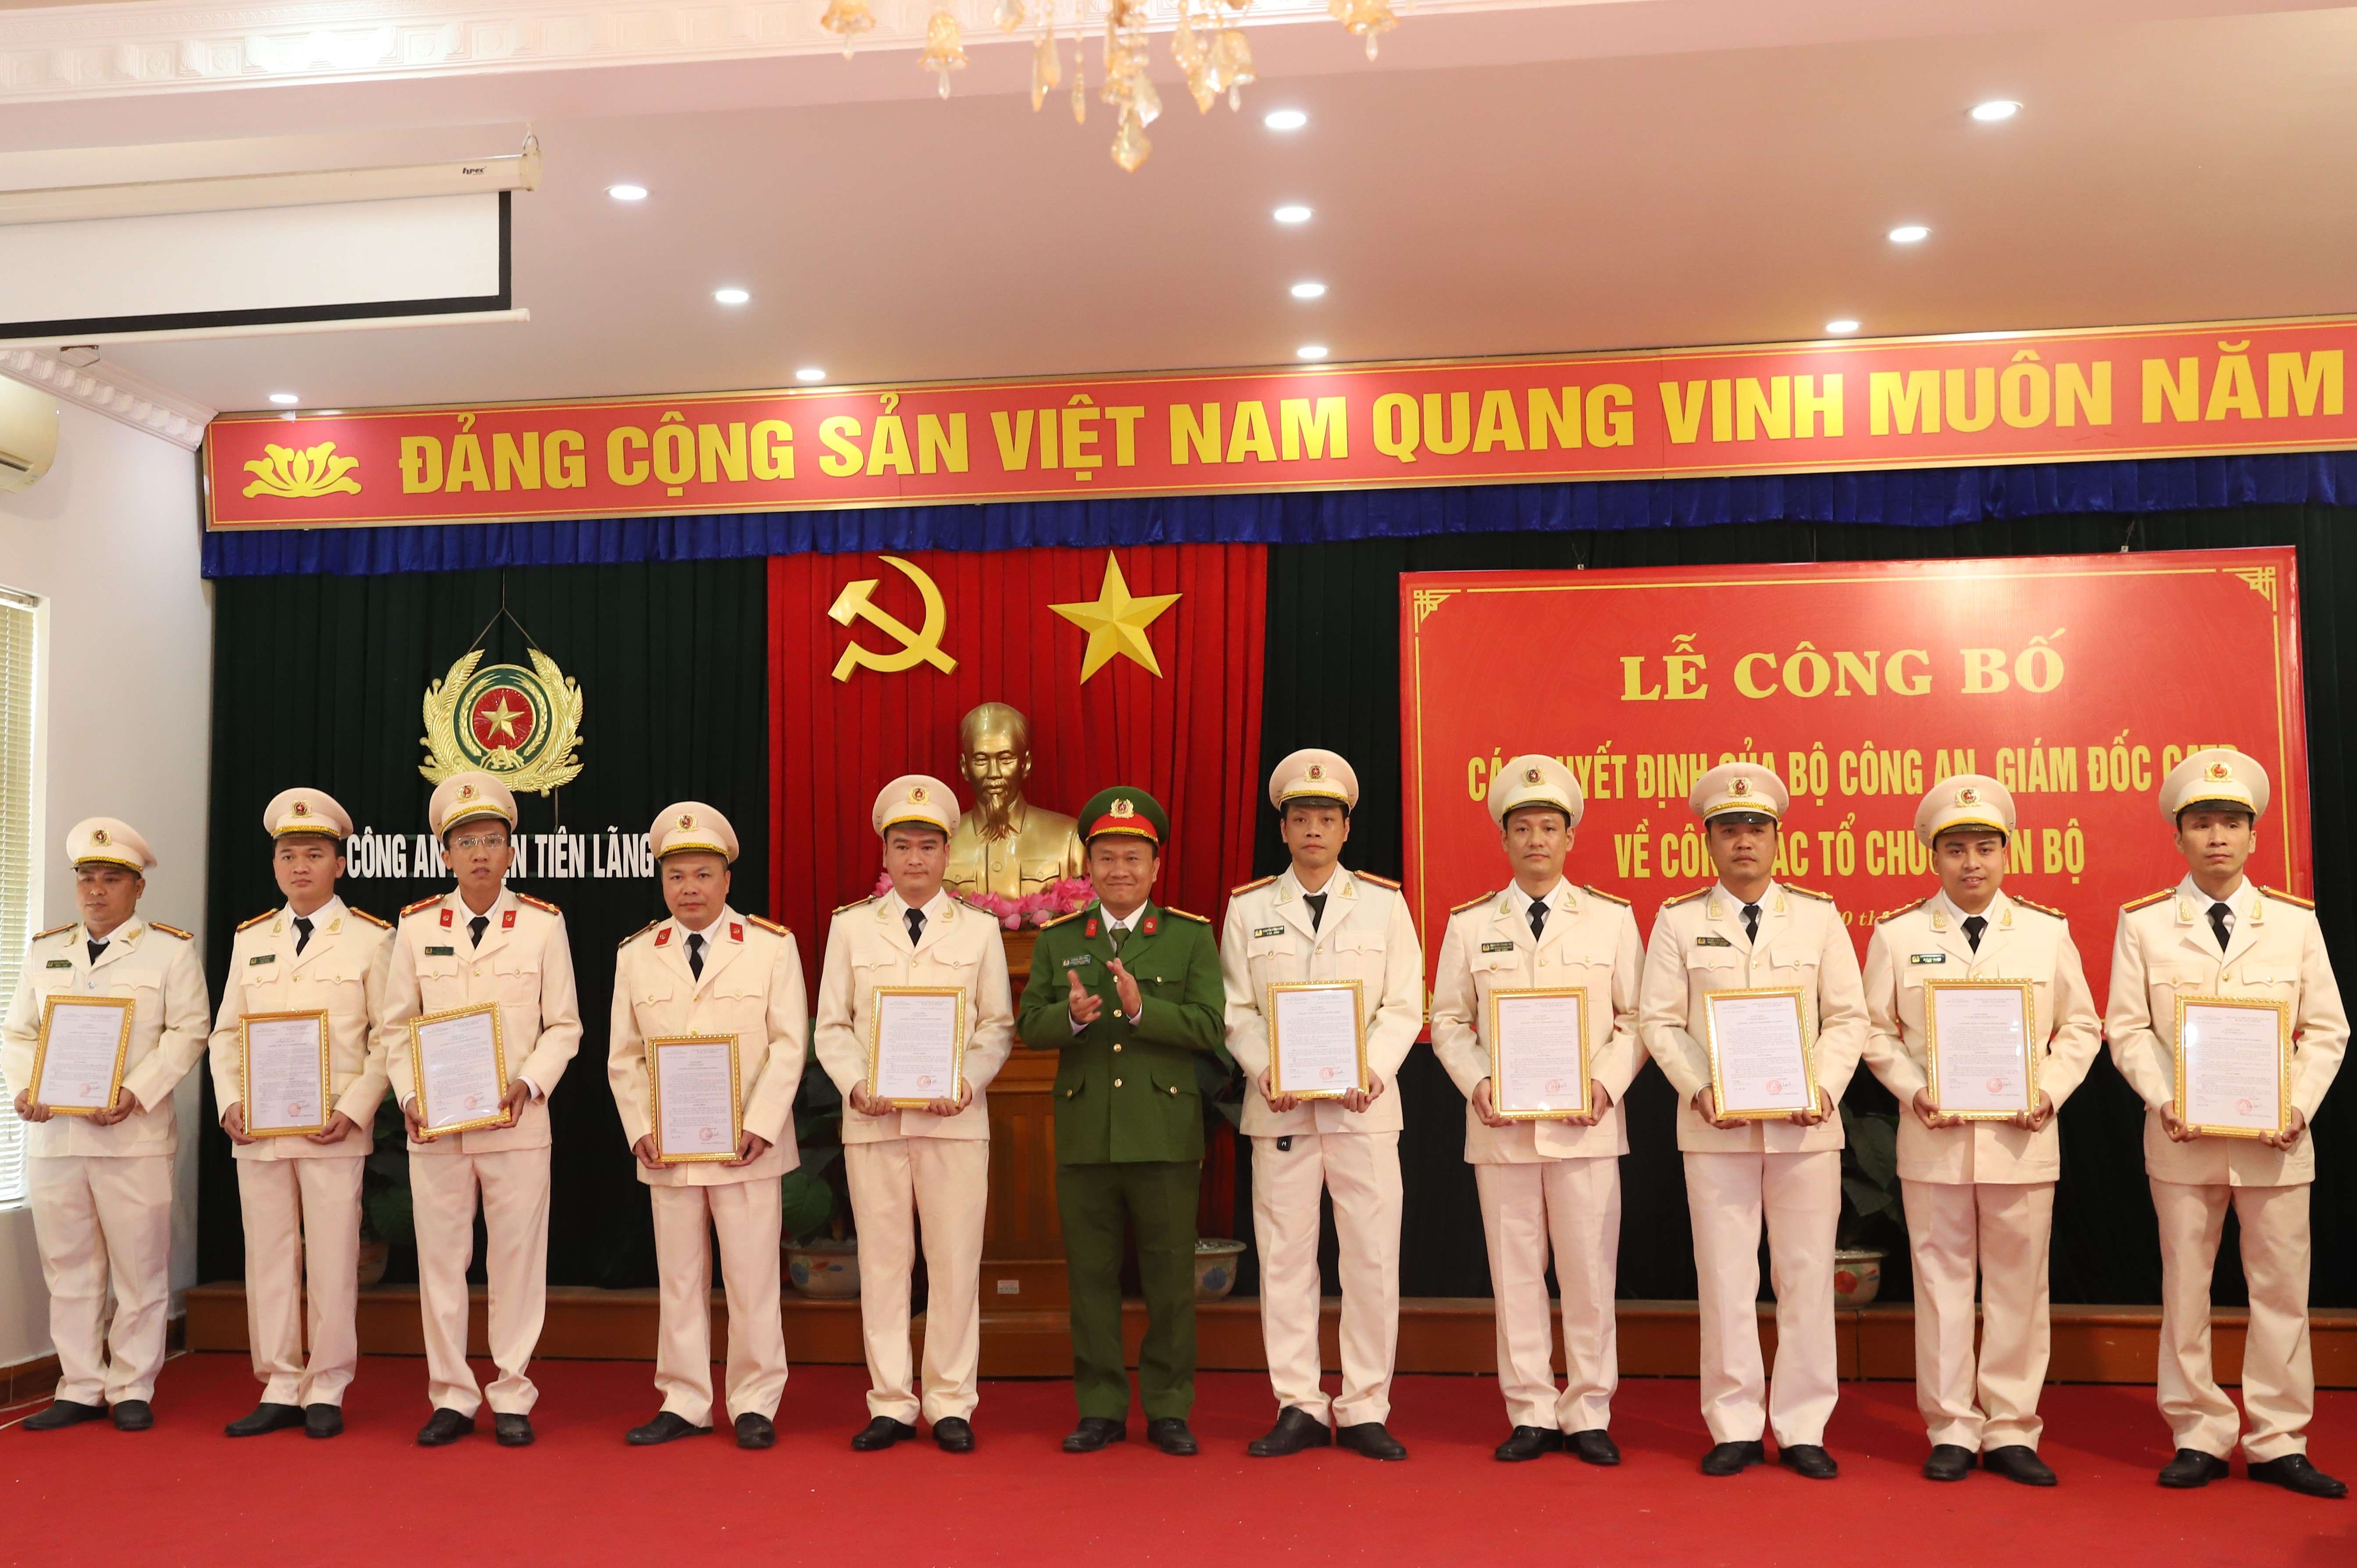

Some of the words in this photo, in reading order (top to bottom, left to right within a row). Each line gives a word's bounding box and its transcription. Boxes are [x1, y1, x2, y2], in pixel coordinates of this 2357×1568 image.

[399, 411, 586, 494] ĐẢNG
[607, 411, 795, 496] CỘNG
[818, 391, 969, 477] SẢN
[991, 394, 1145, 481] VIỆT
[1170, 396, 1349, 464] NAM
[1372, 383, 1634, 463] QUANG
[1659, 374, 1844, 444] VINH
[1869, 350, 2113, 436] MUÔN
[2142, 340, 2344, 424] NĂM
[1620, 633, 1708, 700] LỄ
[1734, 640, 1932, 699] CÔNG
[1960, 627, 2066, 694] BỐ
[1468, 747, 1520, 802] CÁ
[1636, 754, 1709, 809] ĐỊNH
[1789, 741, 1829, 806] BỘ
[1839, 740, 1924, 796] CÔNG
[1996, 737, 2078, 793] GIÁM
[2087, 729, 2152, 792] ĐỐC
[346, 826, 407, 879] CÔNG
[413, 834, 446, 878] AN
[534, 825, 586, 879] TIÊN
[593, 825, 655, 878] LÃNG
[1614, 818, 1650, 878] VỀ
[1818, 811, 1855, 876] TỔ
[2043, 818, 2085, 884] BỘ
